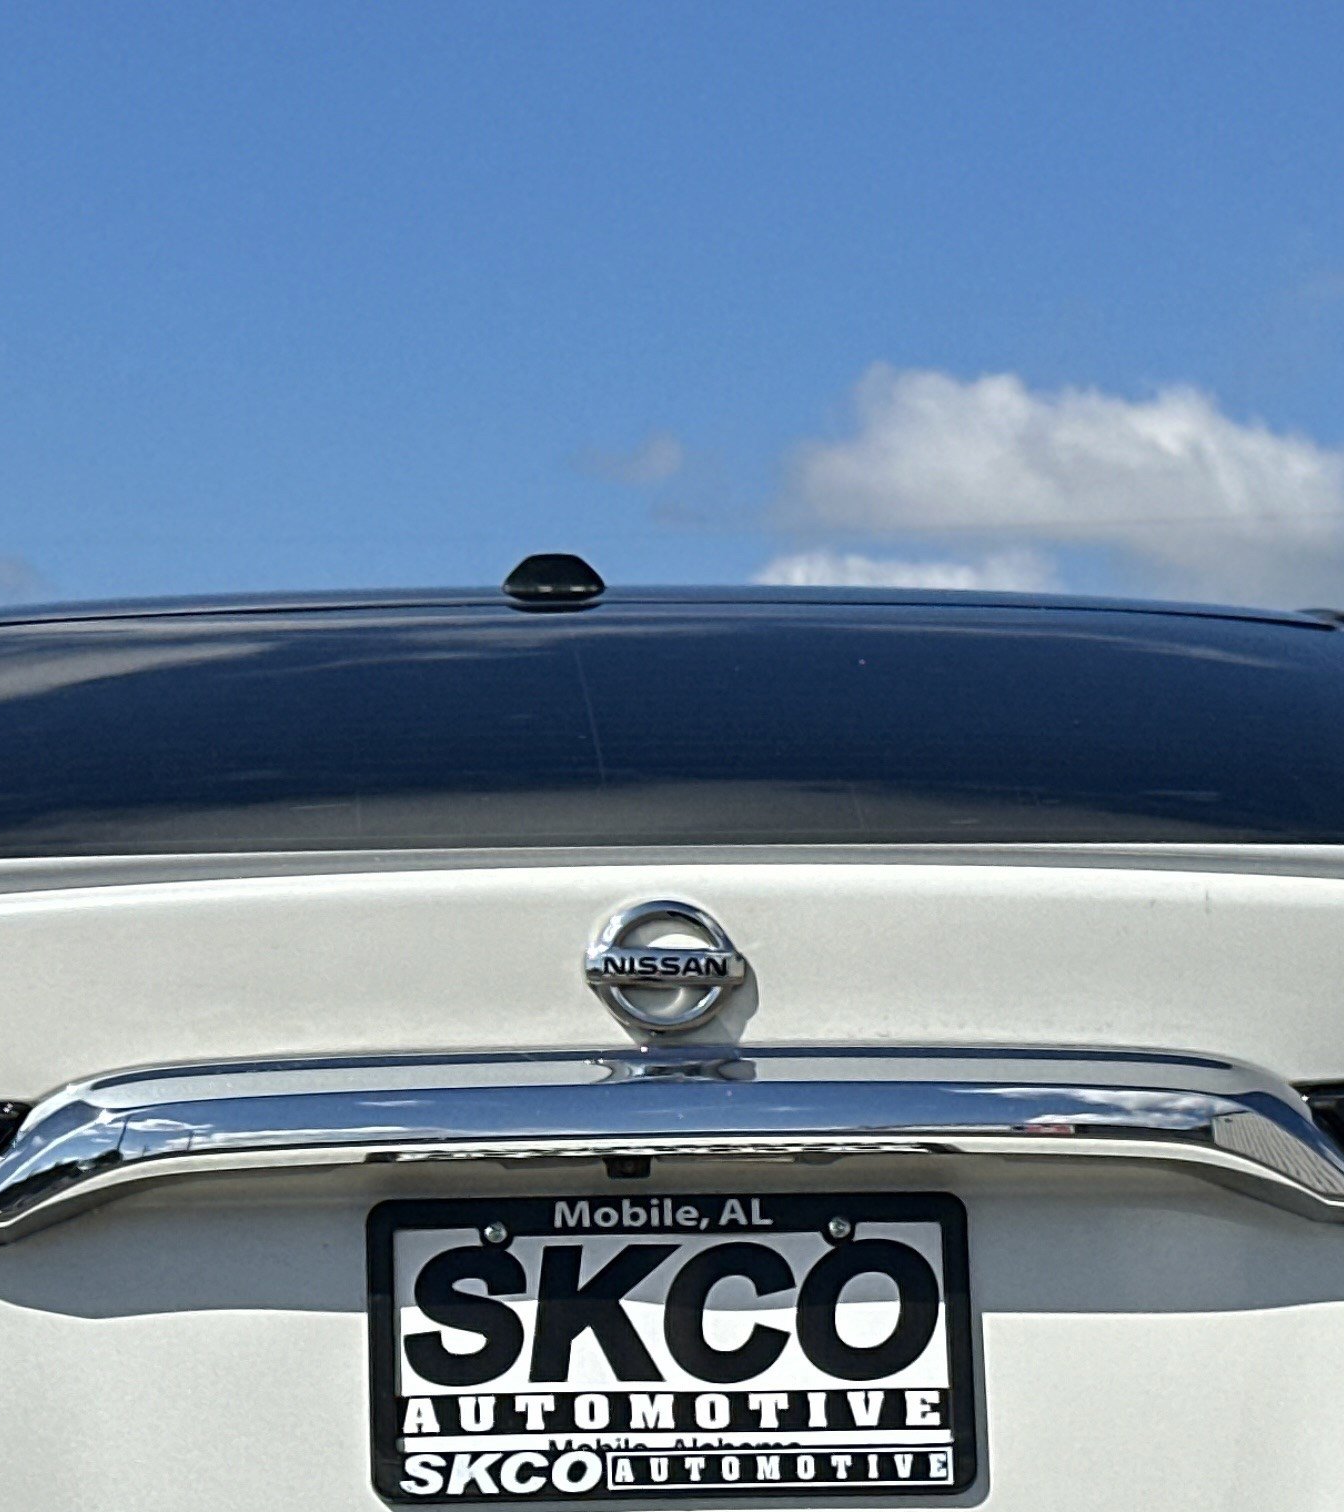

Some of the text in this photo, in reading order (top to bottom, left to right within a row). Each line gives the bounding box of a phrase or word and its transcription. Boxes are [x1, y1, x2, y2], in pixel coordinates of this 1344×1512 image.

[603, 956, 728, 976] NISSAN
[554, 1198, 774, 1230] Mobile, AL
[403, 1239, 940, 1387] SKCO
[402, 1391, 942, 1434] AUTOMOTIVE
[399, 1450, 949, 1496] SKCO AUTOMOTIVE
